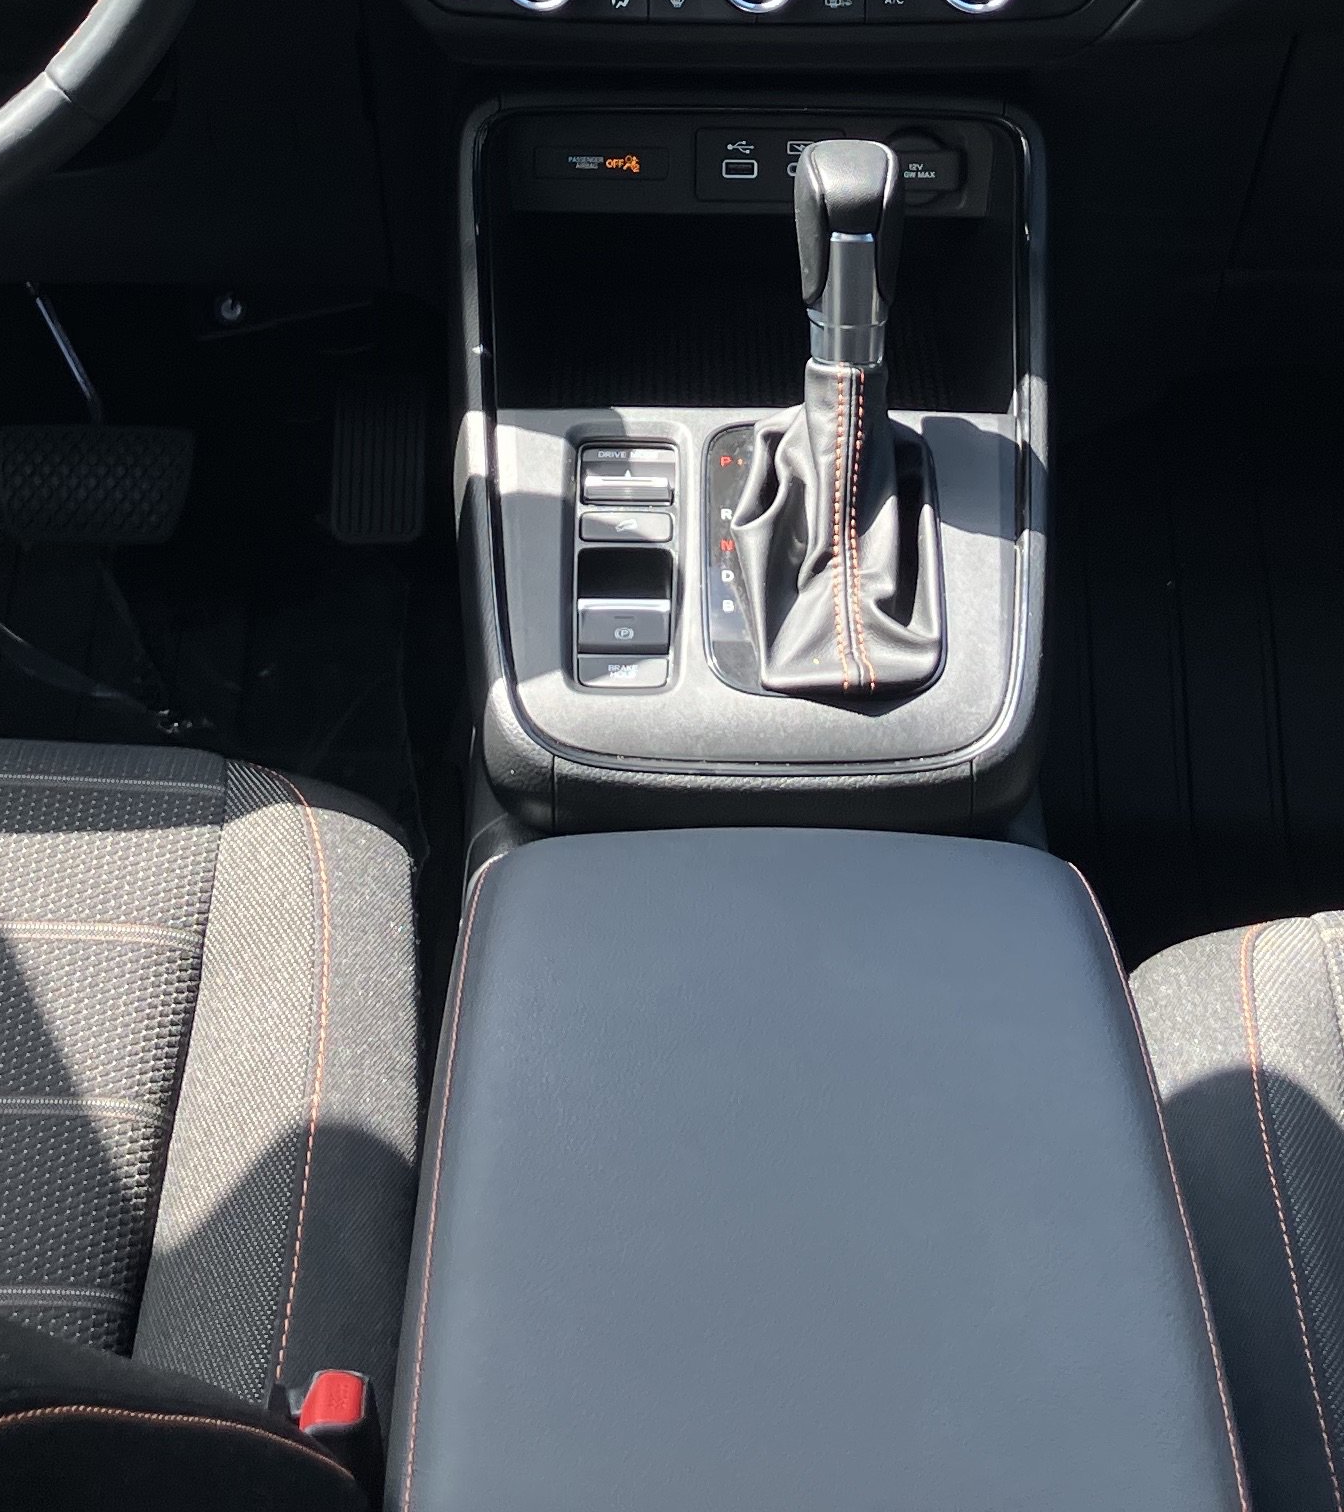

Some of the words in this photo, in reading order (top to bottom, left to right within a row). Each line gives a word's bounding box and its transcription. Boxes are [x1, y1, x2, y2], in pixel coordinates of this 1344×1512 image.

[605, 159, 624, 168] OFF
[908, 163, 924, 171] 12V
[598, 451, 627, 459] DRIVE
[720, 456, 732, 467] P
[720, 508, 732, 520] R
[720, 539, 735, 552] N
[721, 570, 734, 582] D
[722, 600, 734, 612] B
[608, 664, 639, 672] BRAKE
